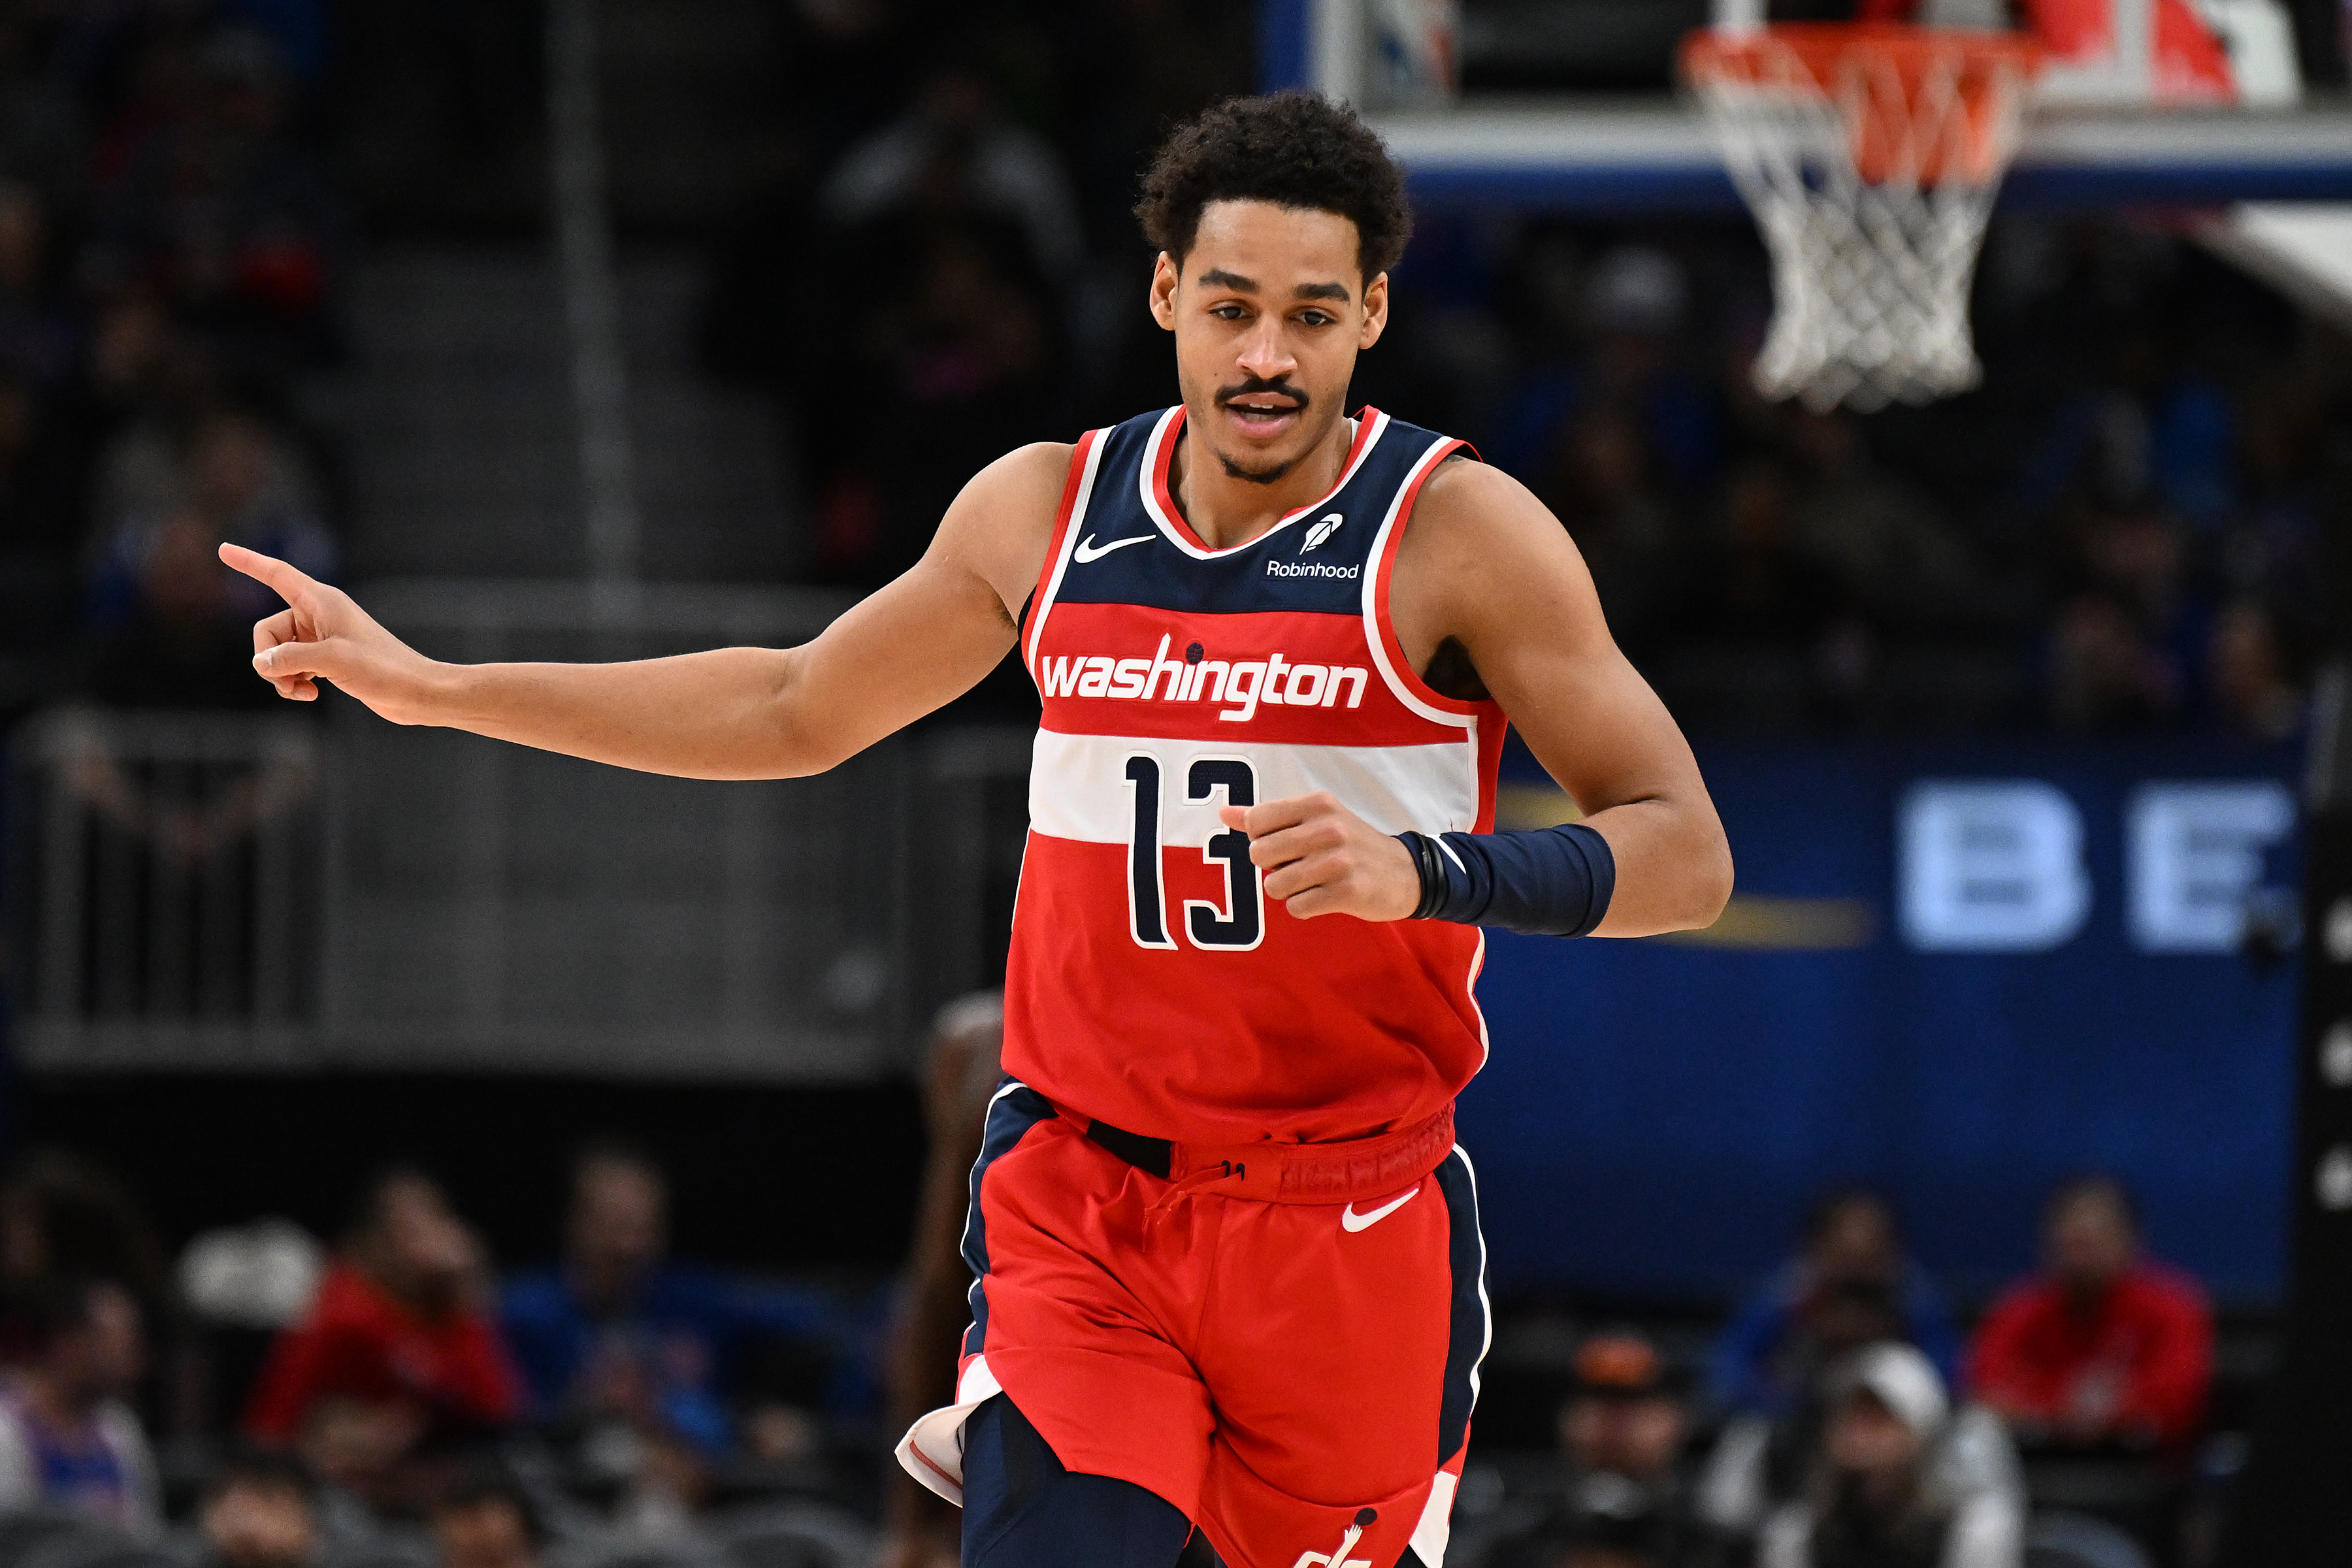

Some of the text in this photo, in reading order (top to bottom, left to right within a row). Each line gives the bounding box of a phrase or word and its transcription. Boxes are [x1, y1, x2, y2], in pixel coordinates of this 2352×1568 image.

[1267, 560, 1360, 579] Robinhood
[1043, 632, 1368, 721] washington
[1122, 751, 1265, 951] 13
[1899, 781, 2295, 953] BE
